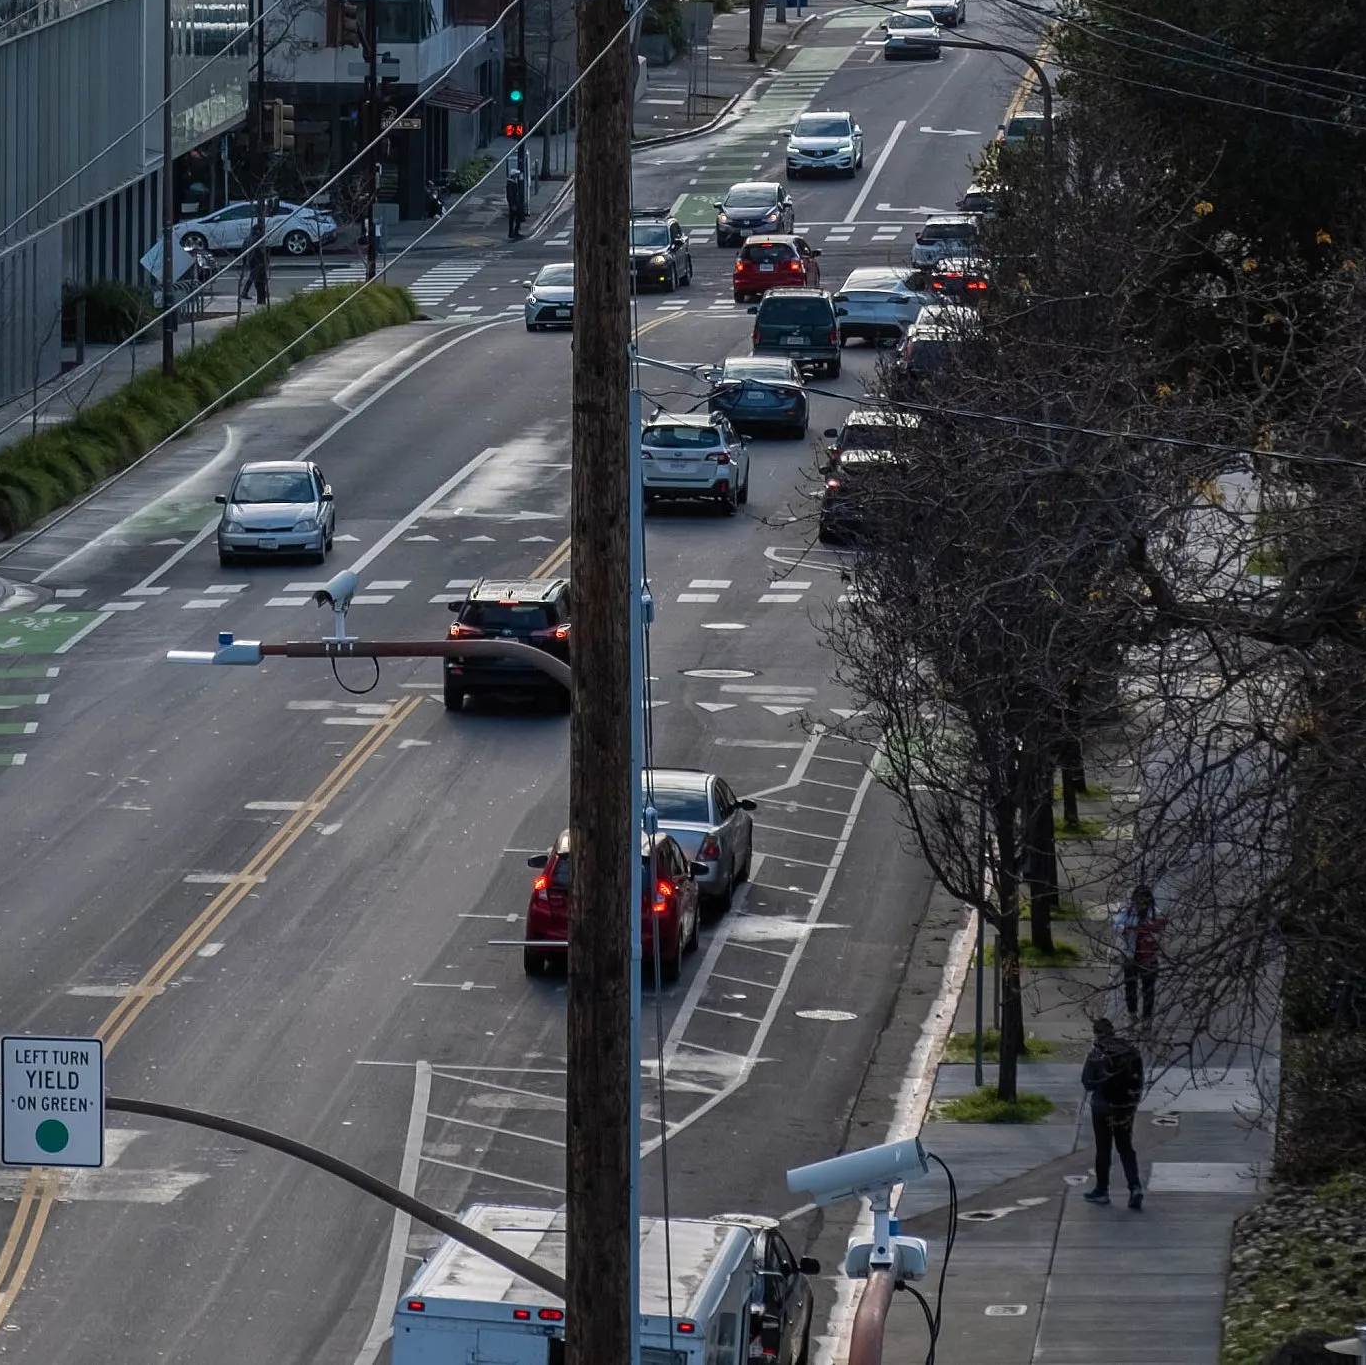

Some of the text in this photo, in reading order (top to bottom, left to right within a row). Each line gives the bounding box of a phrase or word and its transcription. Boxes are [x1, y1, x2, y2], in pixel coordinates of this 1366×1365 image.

[15, 1050, 89, 1066] LEFT TURN
[26, 1070, 79, 1090] YIELD
[17, 1096, 88, 1112] ON GREEN
